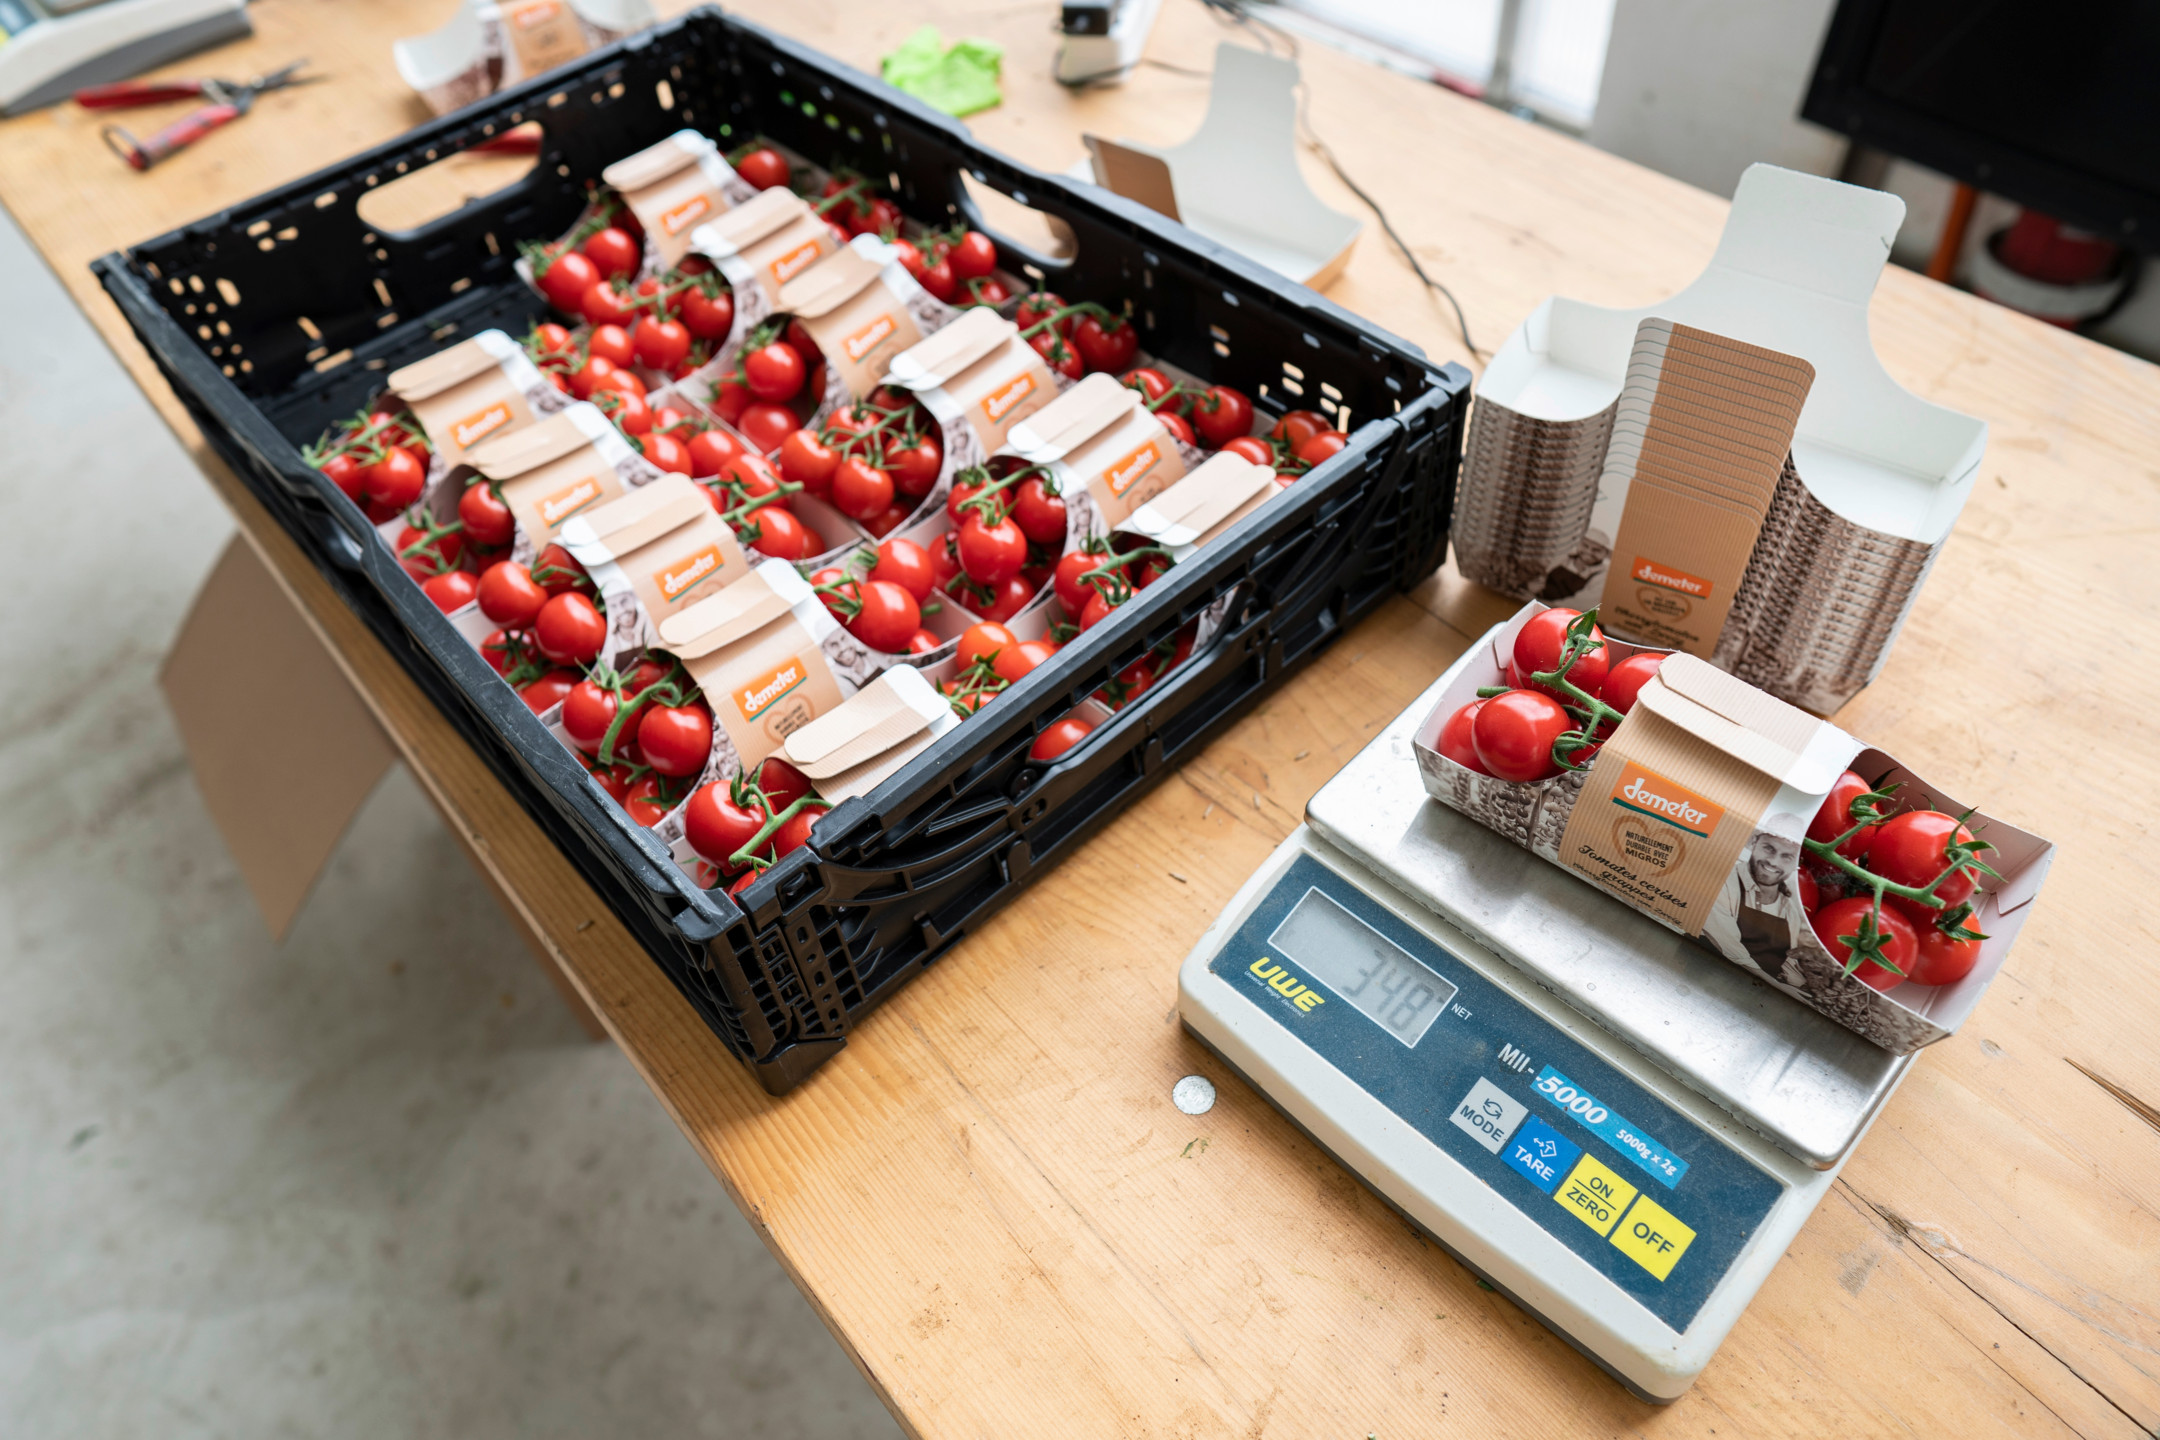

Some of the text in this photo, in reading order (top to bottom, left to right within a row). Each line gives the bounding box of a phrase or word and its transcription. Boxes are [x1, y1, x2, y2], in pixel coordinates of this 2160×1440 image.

[1638, 565, 1702, 592] demeter
[744, 666, 797, 712] demeter
[1623, 777, 1708, 825] demeter
[1625, 830, 1674, 853] NATURELLEMENT
[1625, 839, 1670, 861] DURABLE AVEC
[1625, 847, 1667, 869] MIGROS
[1578, 844, 1688, 909] Tomates cerises
[1600, 870, 1656, 902] grappes
[1244, 970, 1265, 987] Universal
[1249, 956, 1326, 1013] UWE
[1341, 949, 1435, 1033] 348
[1451, 1003, 1473, 1021] NET
[1459, 1104, 1505, 1143] MODE
[1513, 1144, 1556, 1182] TARE
[1615, 1128, 1653, 1161] 5000g
[1651, 1154, 1660, 1165] x
[1659, 1157, 1678, 1177] 2g
[1565, 1186, 1610, 1223] ZERO
[1589, 1176, 1615, 1199] ON
[1632, 1221, 1676, 1255] OFF
